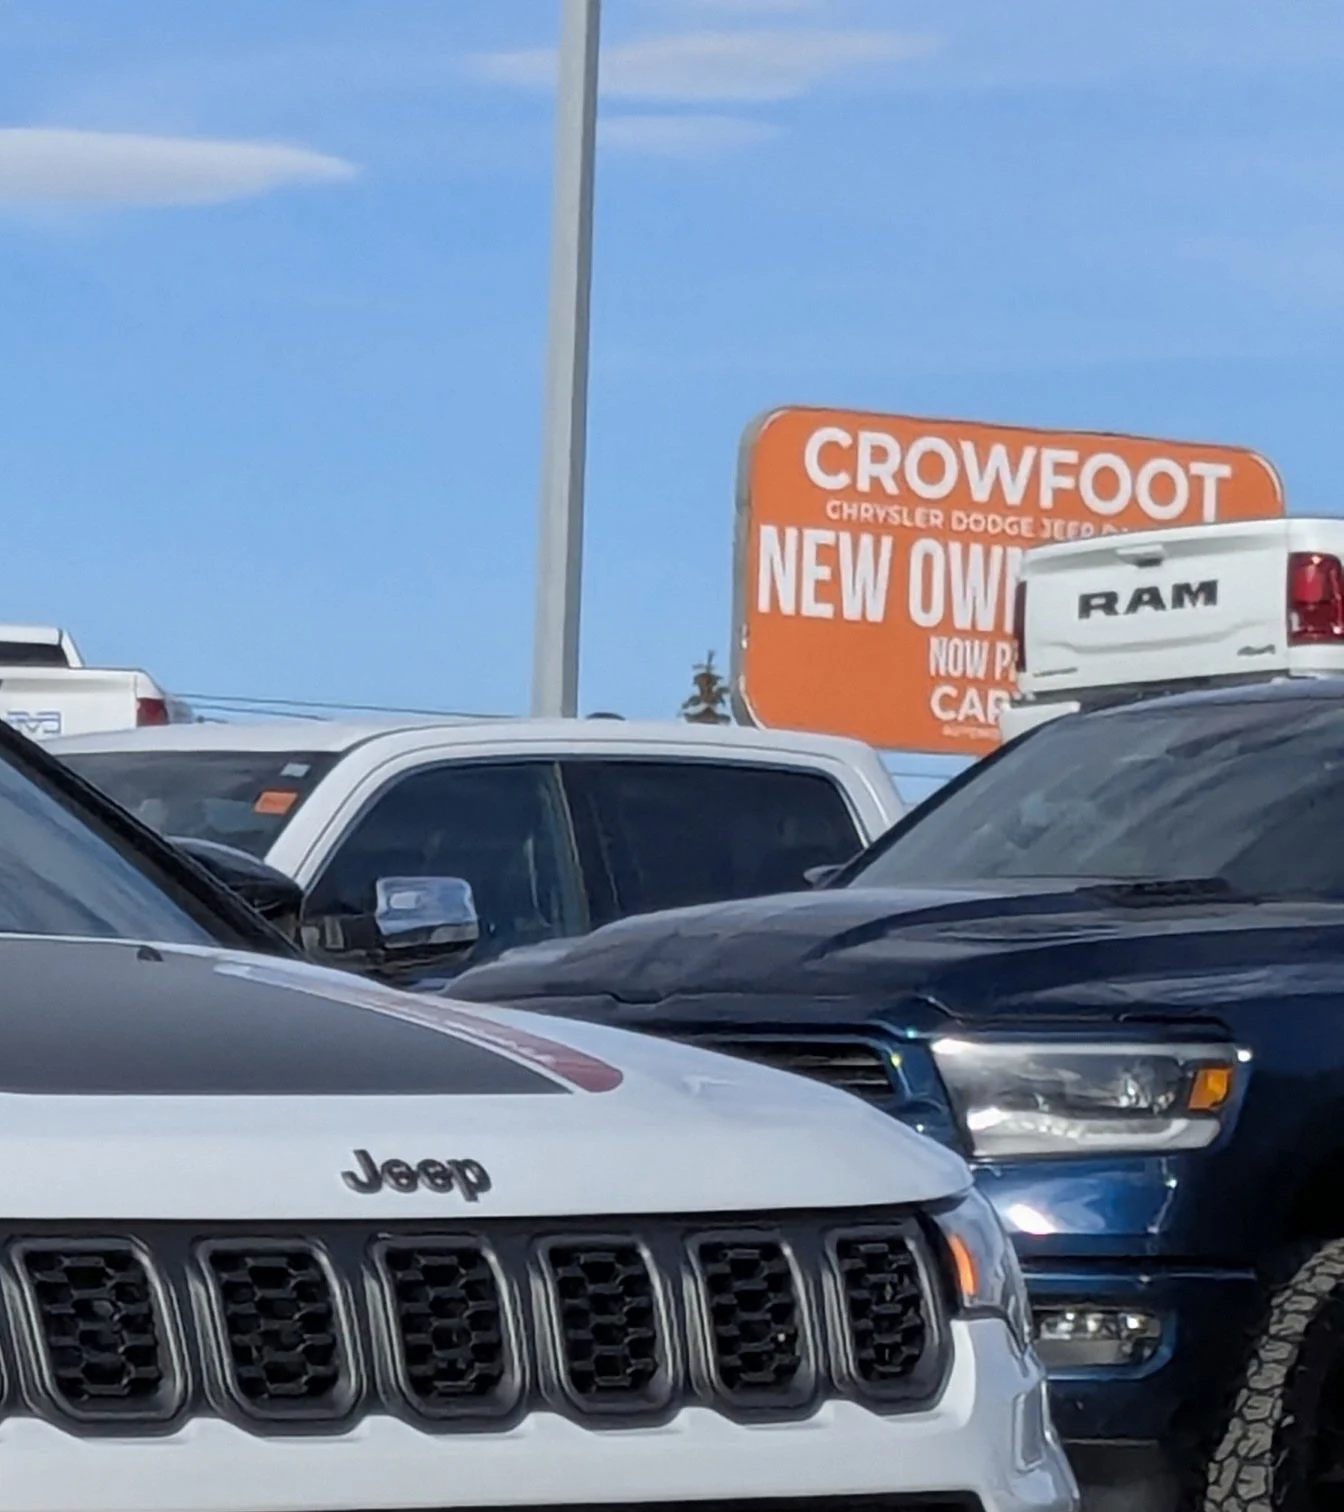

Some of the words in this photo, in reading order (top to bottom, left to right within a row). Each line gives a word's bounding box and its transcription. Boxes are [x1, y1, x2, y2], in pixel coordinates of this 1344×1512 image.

[803, 426, 1233, 524] CROWFOOT
[825, 499, 945, 529] CHRYSLER
[950, 509, 1035, 538] DODGE
[757, 524, 893, 623] NEW
[1078, 579, 1219, 620] RAM
[929, 635, 990, 680] NOW
[340, 1149, 492, 1202] Jeep
